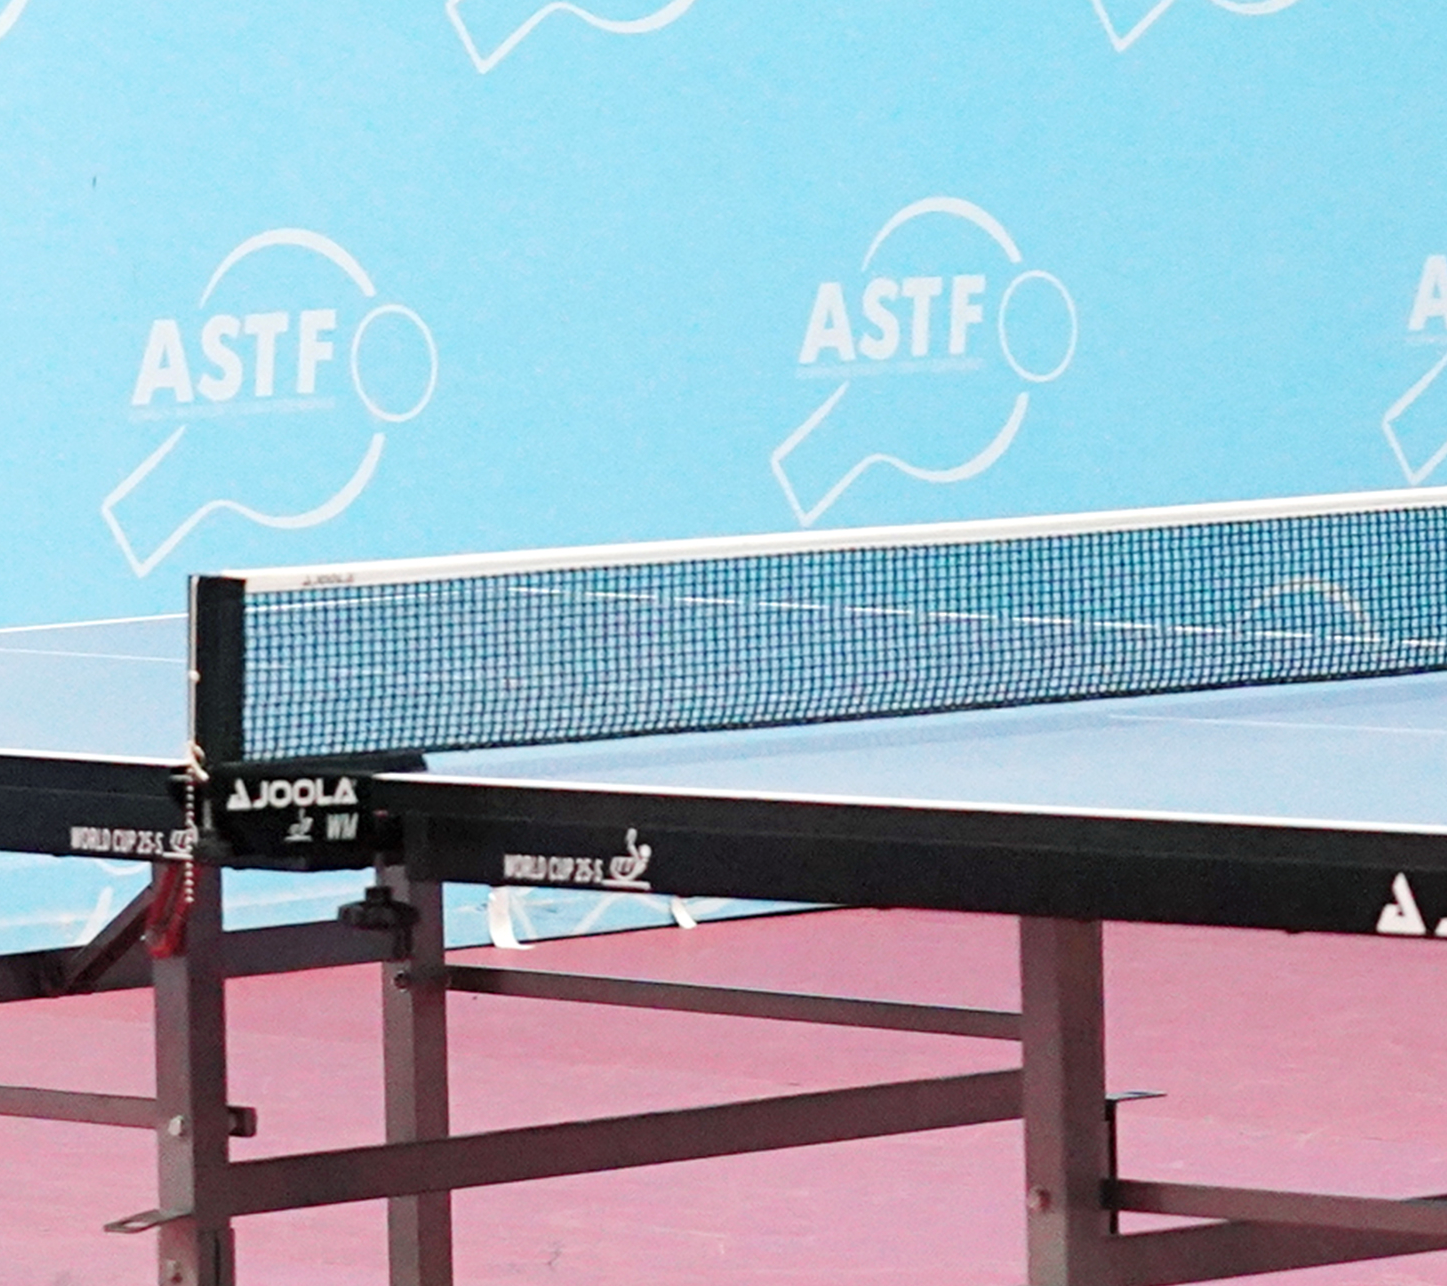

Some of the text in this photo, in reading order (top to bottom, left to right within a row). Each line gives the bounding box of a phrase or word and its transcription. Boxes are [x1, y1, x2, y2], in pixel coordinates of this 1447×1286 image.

[797, 274, 987, 364] ASTF
[131, 309, 337, 406] ASTF
[253, 776, 358, 809] JOOLA
[70, 826, 111, 852] WORLD
[113, 829, 136, 853] CUP
[504, 854, 547, 880] WORLD
[549, 856, 574, 882] CUP
